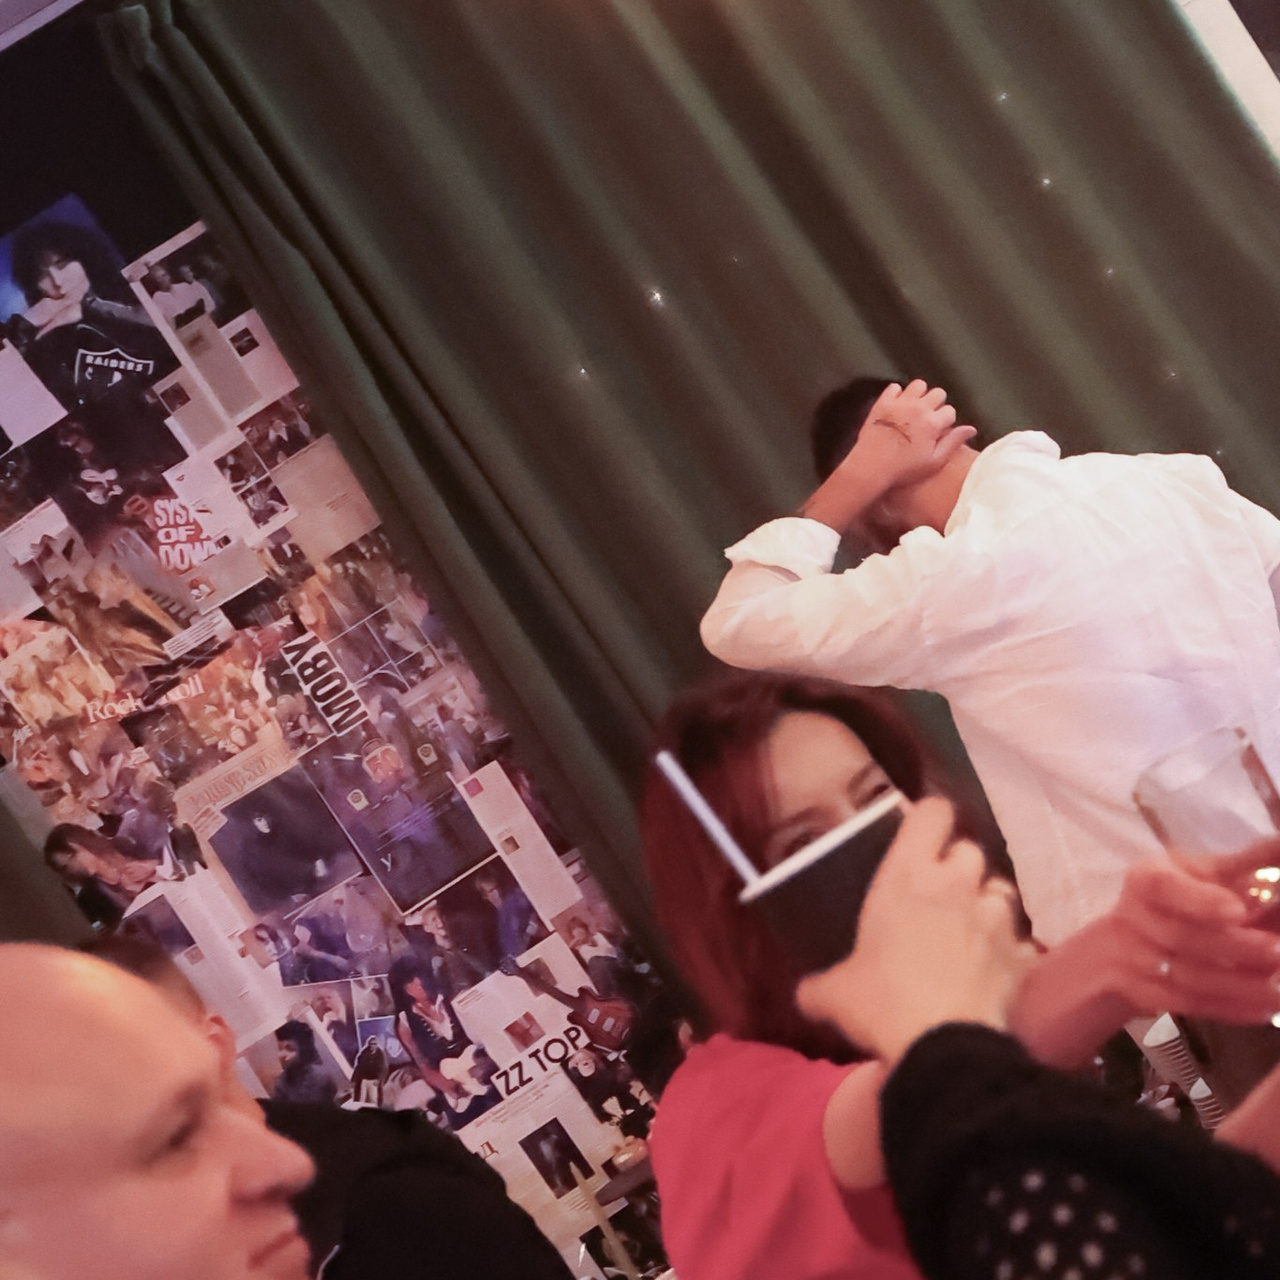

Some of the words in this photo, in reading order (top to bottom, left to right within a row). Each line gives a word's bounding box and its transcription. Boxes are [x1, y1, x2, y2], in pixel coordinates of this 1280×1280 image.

[86, 355, 144, 372] RAIDERS
[154, 499, 195, 527] SYST
[157, 525, 195, 543] OF
[282, 635, 370, 735] MOBY
[86, 692, 141, 723] Rock
[495, 1061, 533, 1096] ZZ
[528, 1026, 582, 1072] TOP
